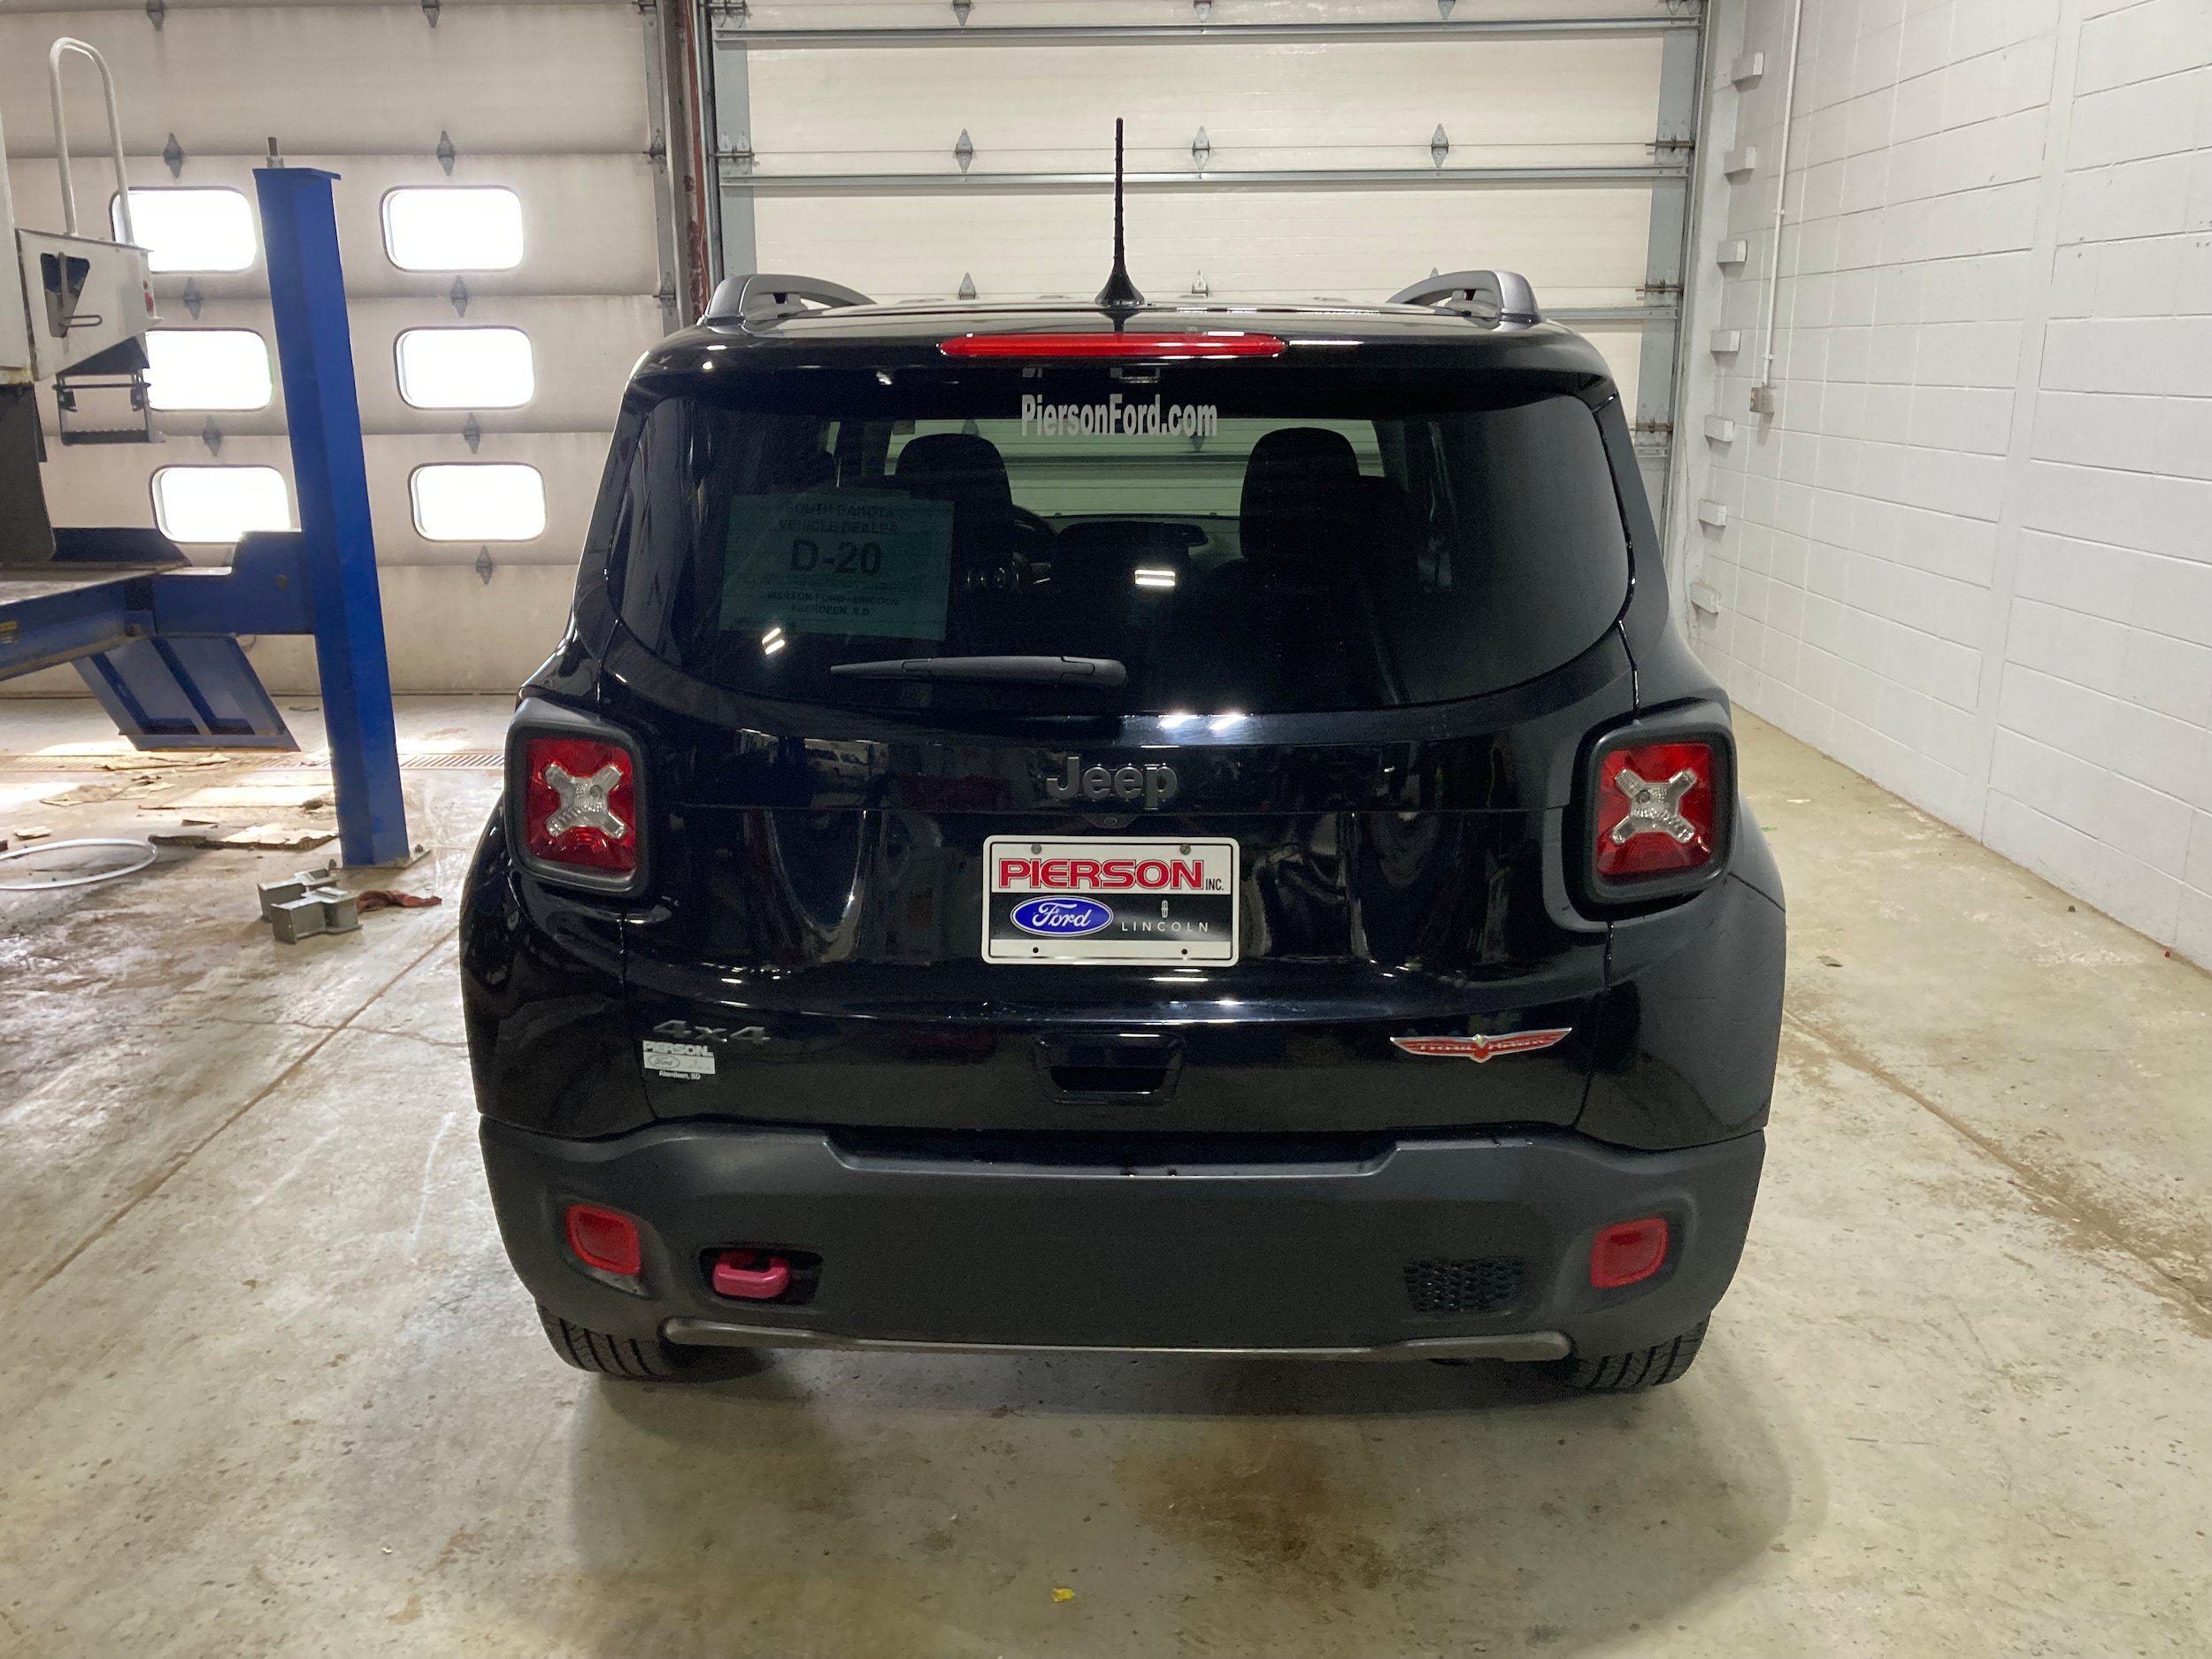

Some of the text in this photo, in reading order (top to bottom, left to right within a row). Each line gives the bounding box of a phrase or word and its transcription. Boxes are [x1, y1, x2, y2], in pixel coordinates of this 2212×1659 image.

[1022, 393, 1217, 437] PiersonFord.com
[841, 520, 899, 535] DEALER
[790, 539, 881, 575] D-20
[1047, 756, 1178, 810] Jeep
[998, 857, 1225, 891] PIERSON INC.
[1032, 902, 1093, 928] Ford
[1121, 921, 1209, 933] LINCOLN
[643, 1041, 709, 1057] PIERSON
